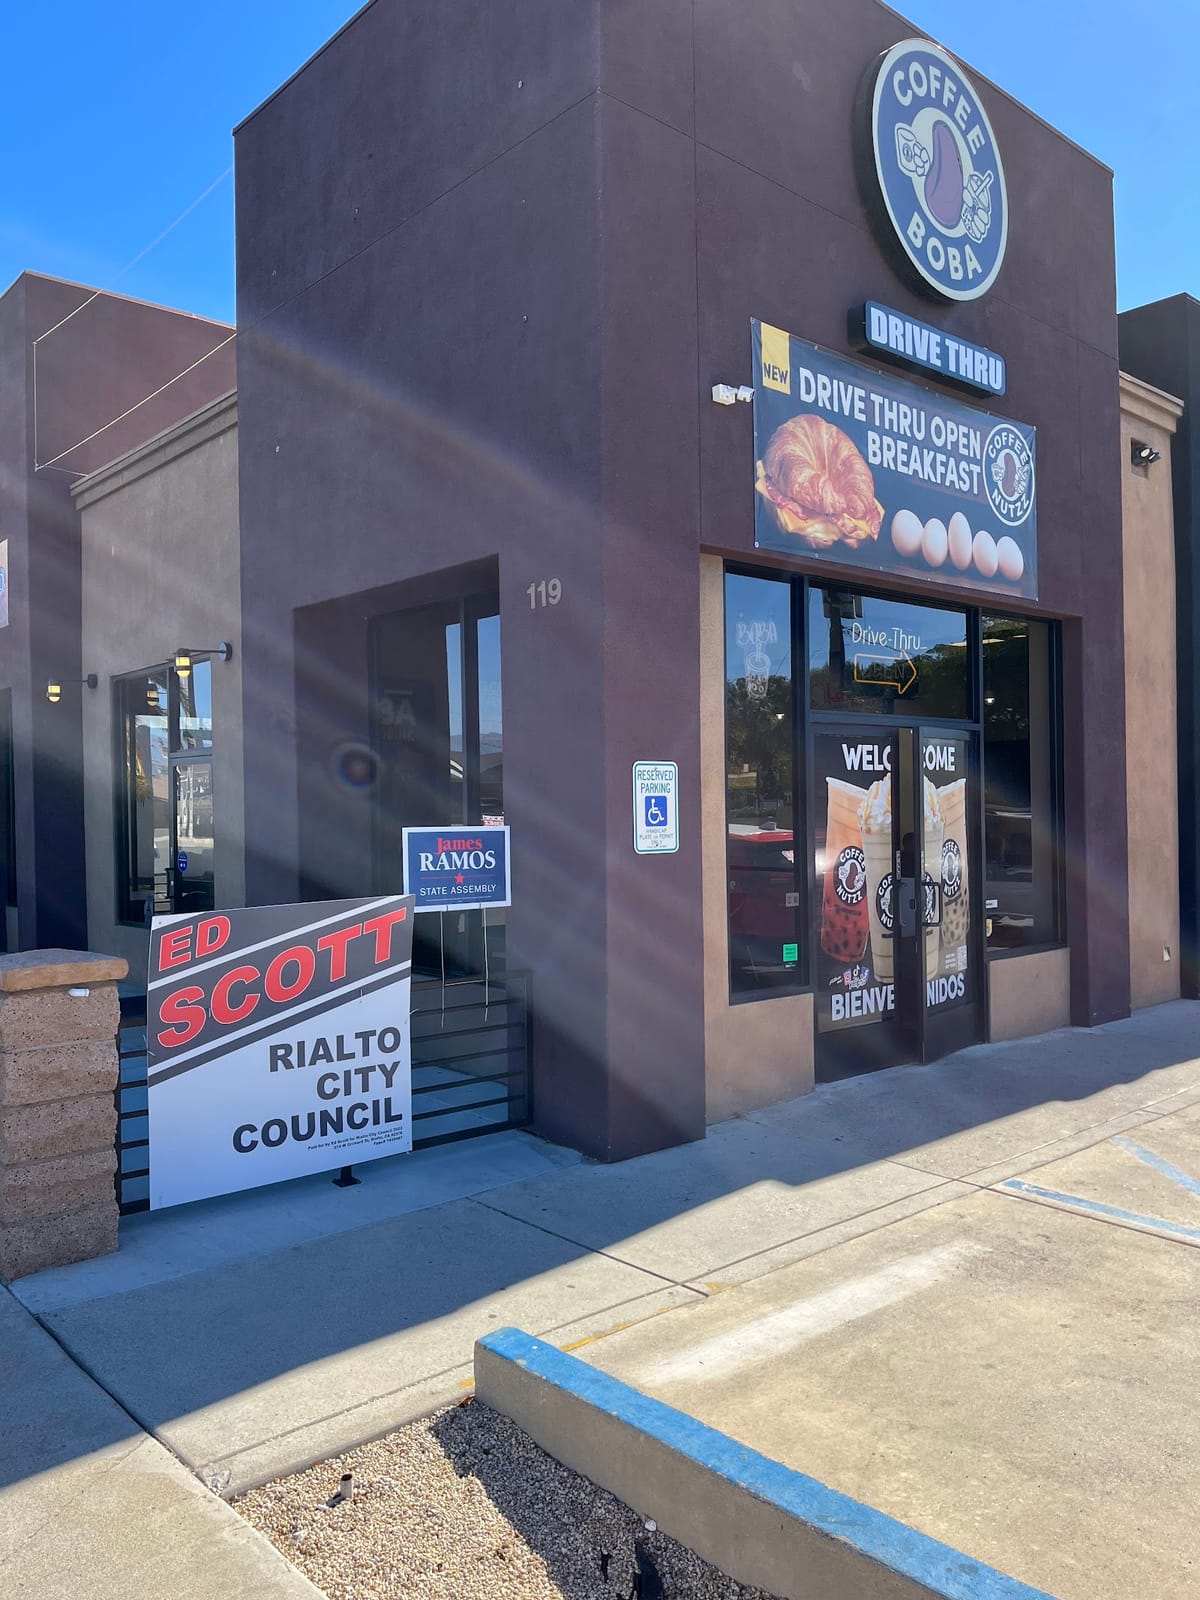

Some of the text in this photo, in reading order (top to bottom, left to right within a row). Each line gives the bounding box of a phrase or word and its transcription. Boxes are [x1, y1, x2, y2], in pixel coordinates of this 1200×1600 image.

[893, 61, 986, 155] COFFEE
[907, 211, 983, 281] BOBA
[870, 306, 1003, 390] DRIVE THRU
[763, 361, 789, 384] NEW
[800, 367, 981, 460] DRIVE THRU OPEN
[867, 430, 981, 495] BREAKFAST
[988, 432, 1028, 465] COFFEE
[992, 488, 1029, 518] NUTZZ
[526, 578, 562, 609] 119
[637, 769, 673, 781] RESERVED
[641, 782, 671, 793] PARKING
[419, 850, 496, 872] RAMOS
[434, 838, 483, 855] James
[420, 884, 496, 896] STATE ASSEMBLY
[158, 915, 231, 971] ED
[157, 907, 407, 1048] SCOTT
[268, 1026, 401, 1073] RIALTO
[316, 1061, 401, 1101] CITY
[232, 1097, 403, 1154] COUNCIL
